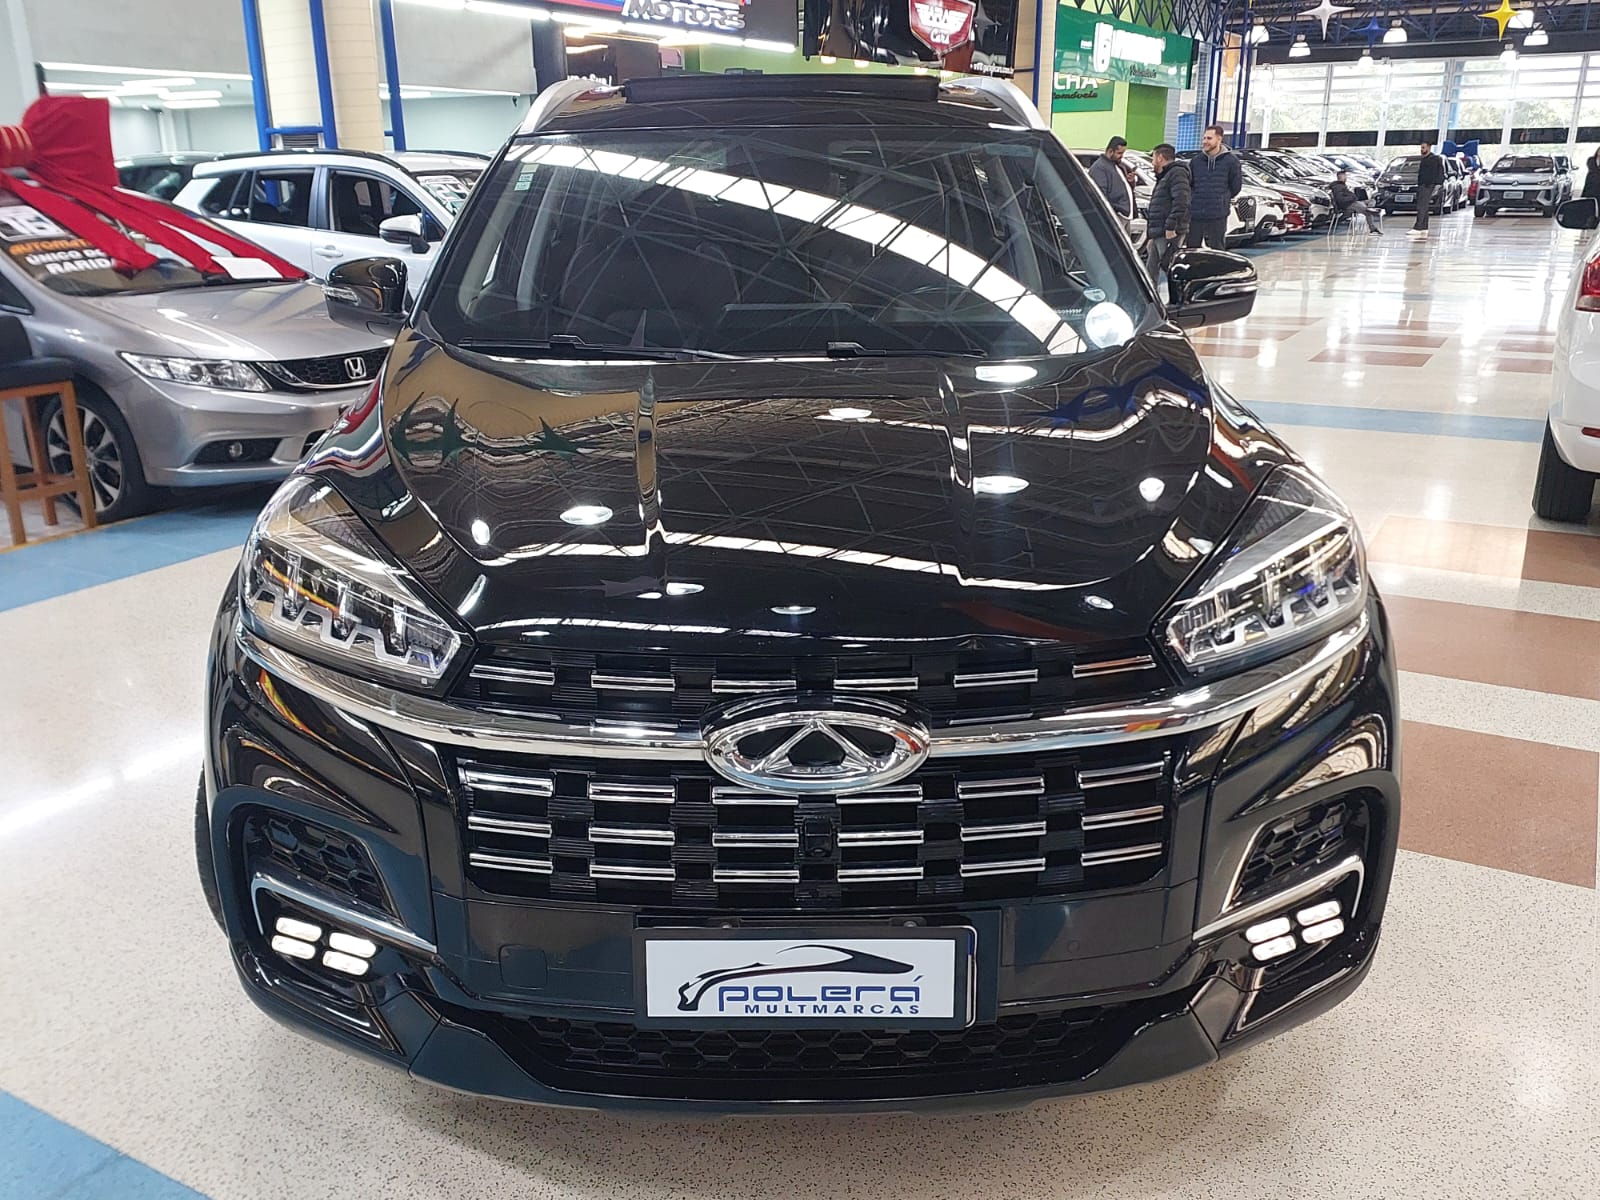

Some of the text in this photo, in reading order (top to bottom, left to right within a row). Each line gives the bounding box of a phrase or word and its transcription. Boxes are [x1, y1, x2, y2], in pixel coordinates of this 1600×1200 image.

[622, 0, 746, 30] MOTORS
[1053, 90, 1098, 99] omóveis
[9, 238, 91, 255] AUTOMAT
[25, 250, 82, 265] ÚNICO
[745, 1004, 920, 1014] MULTMARCAS
